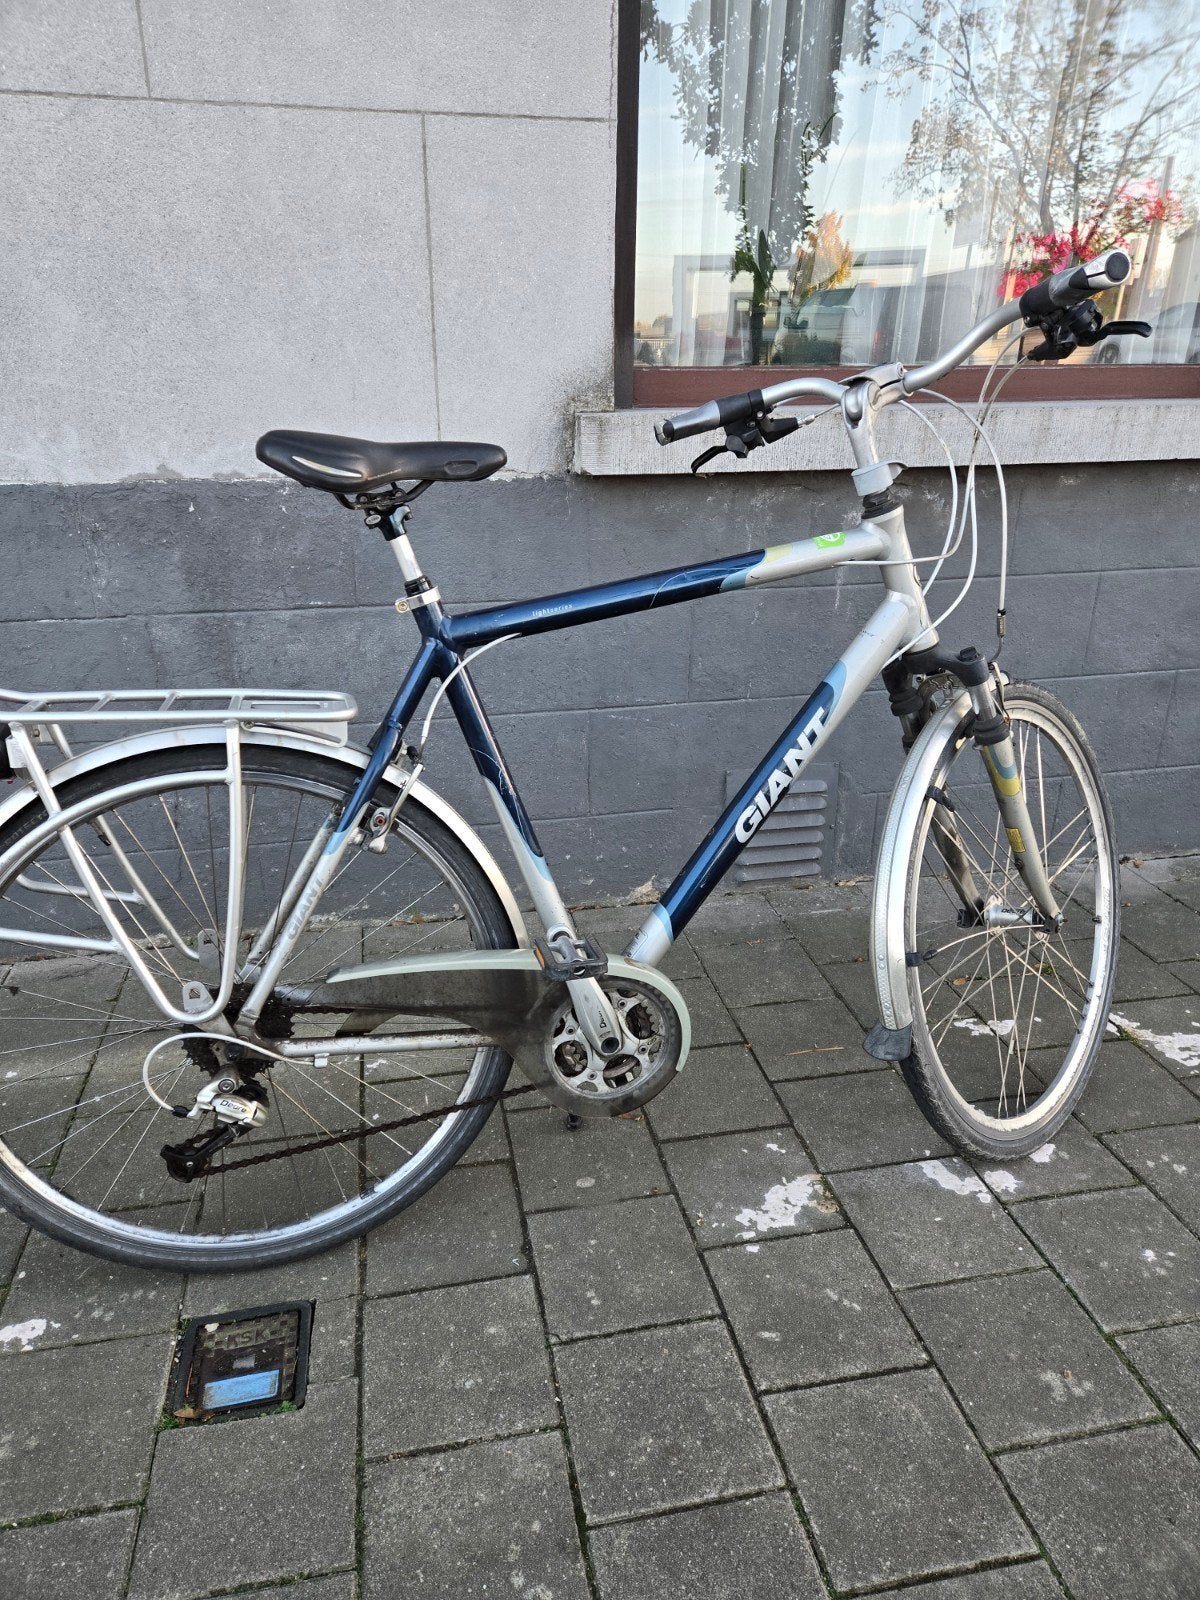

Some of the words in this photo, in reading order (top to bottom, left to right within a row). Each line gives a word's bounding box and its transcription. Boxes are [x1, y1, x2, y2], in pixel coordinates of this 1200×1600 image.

[734, 706, 827, 844] GIANT
[285, 870, 324, 941] GIANT
[220, 1099, 247, 1113] Deore
